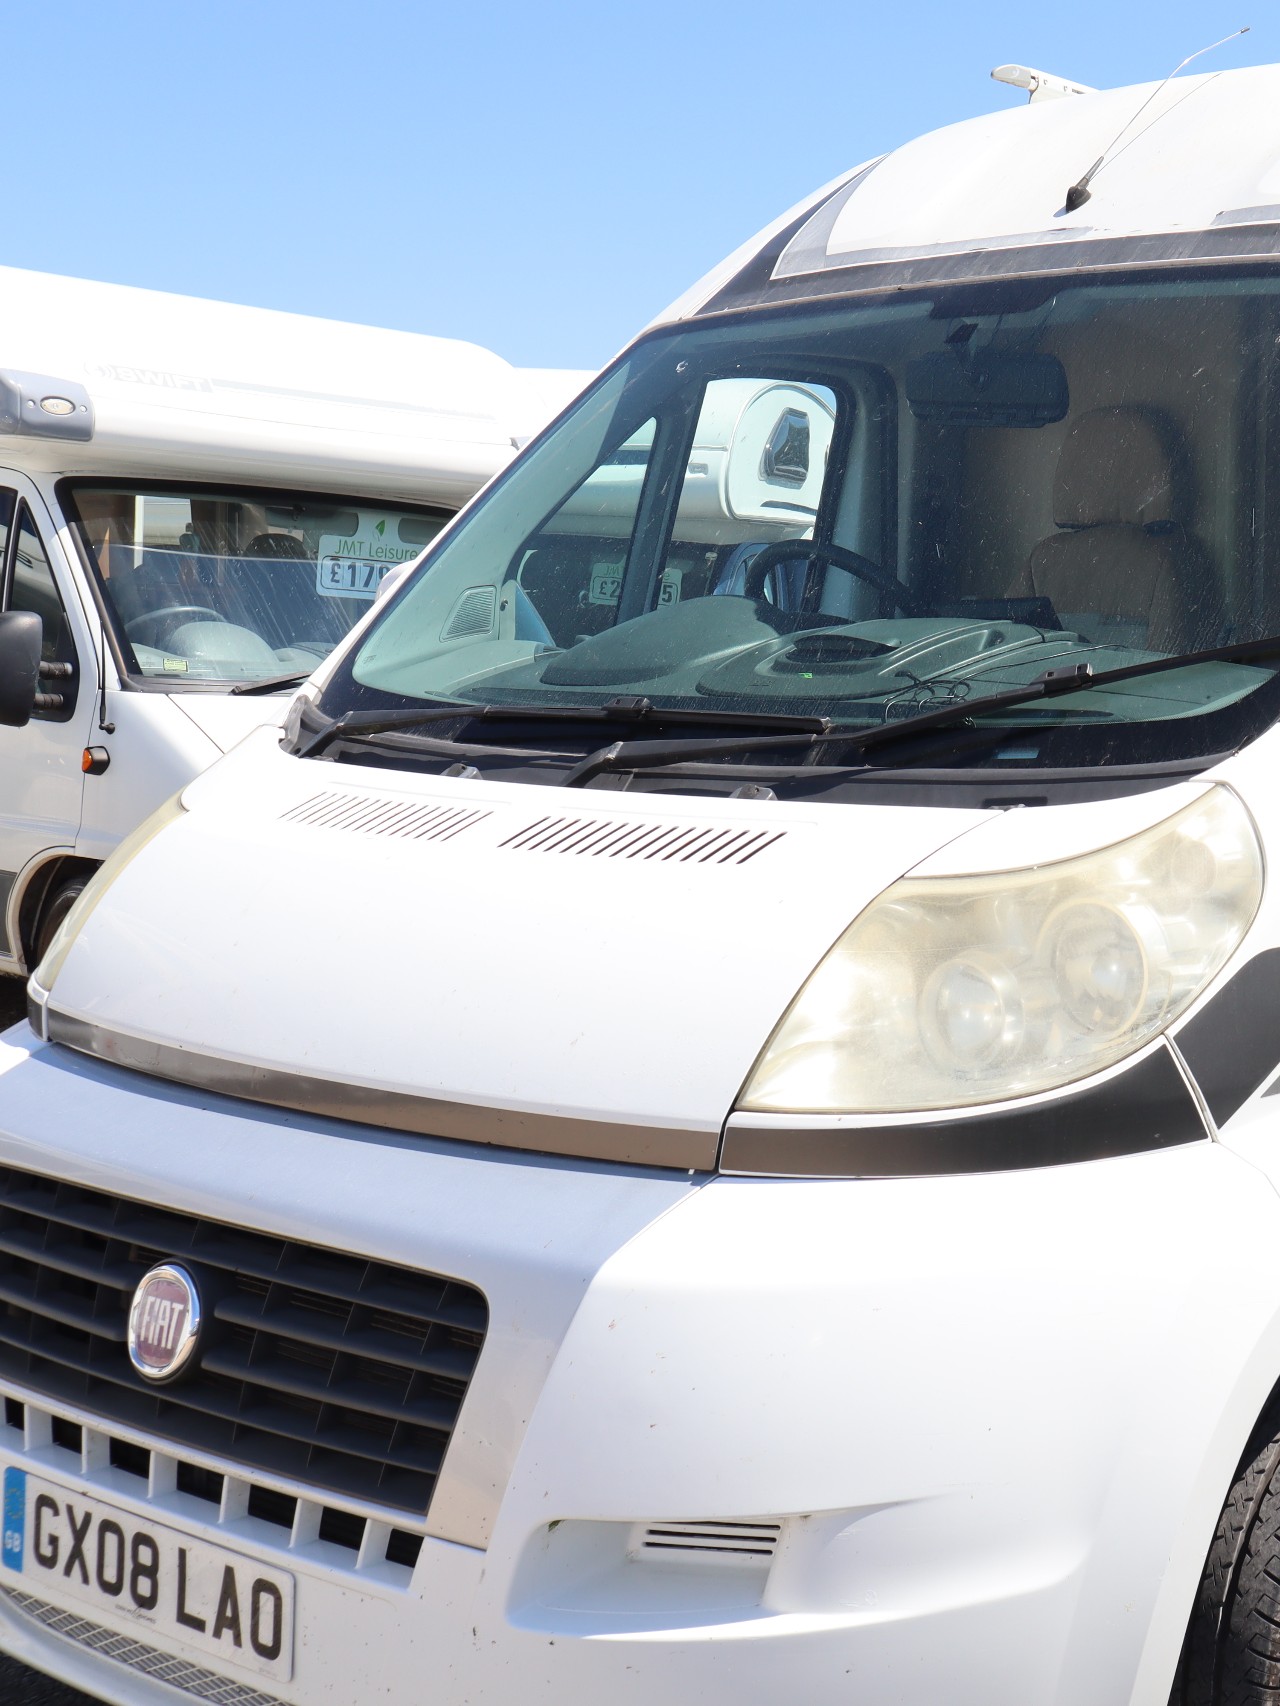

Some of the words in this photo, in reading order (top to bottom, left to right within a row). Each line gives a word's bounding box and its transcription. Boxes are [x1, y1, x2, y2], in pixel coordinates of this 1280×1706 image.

[115, 366, 207, 391] SWIFT
[334, 539, 365, 556] JMT
[368, 541, 418, 560] Leisure
[140, 1295, 185, 1350] FIAT
[33, 1493, 160, 1611] GX08
[175, 1546, 283, 1661] LAO
